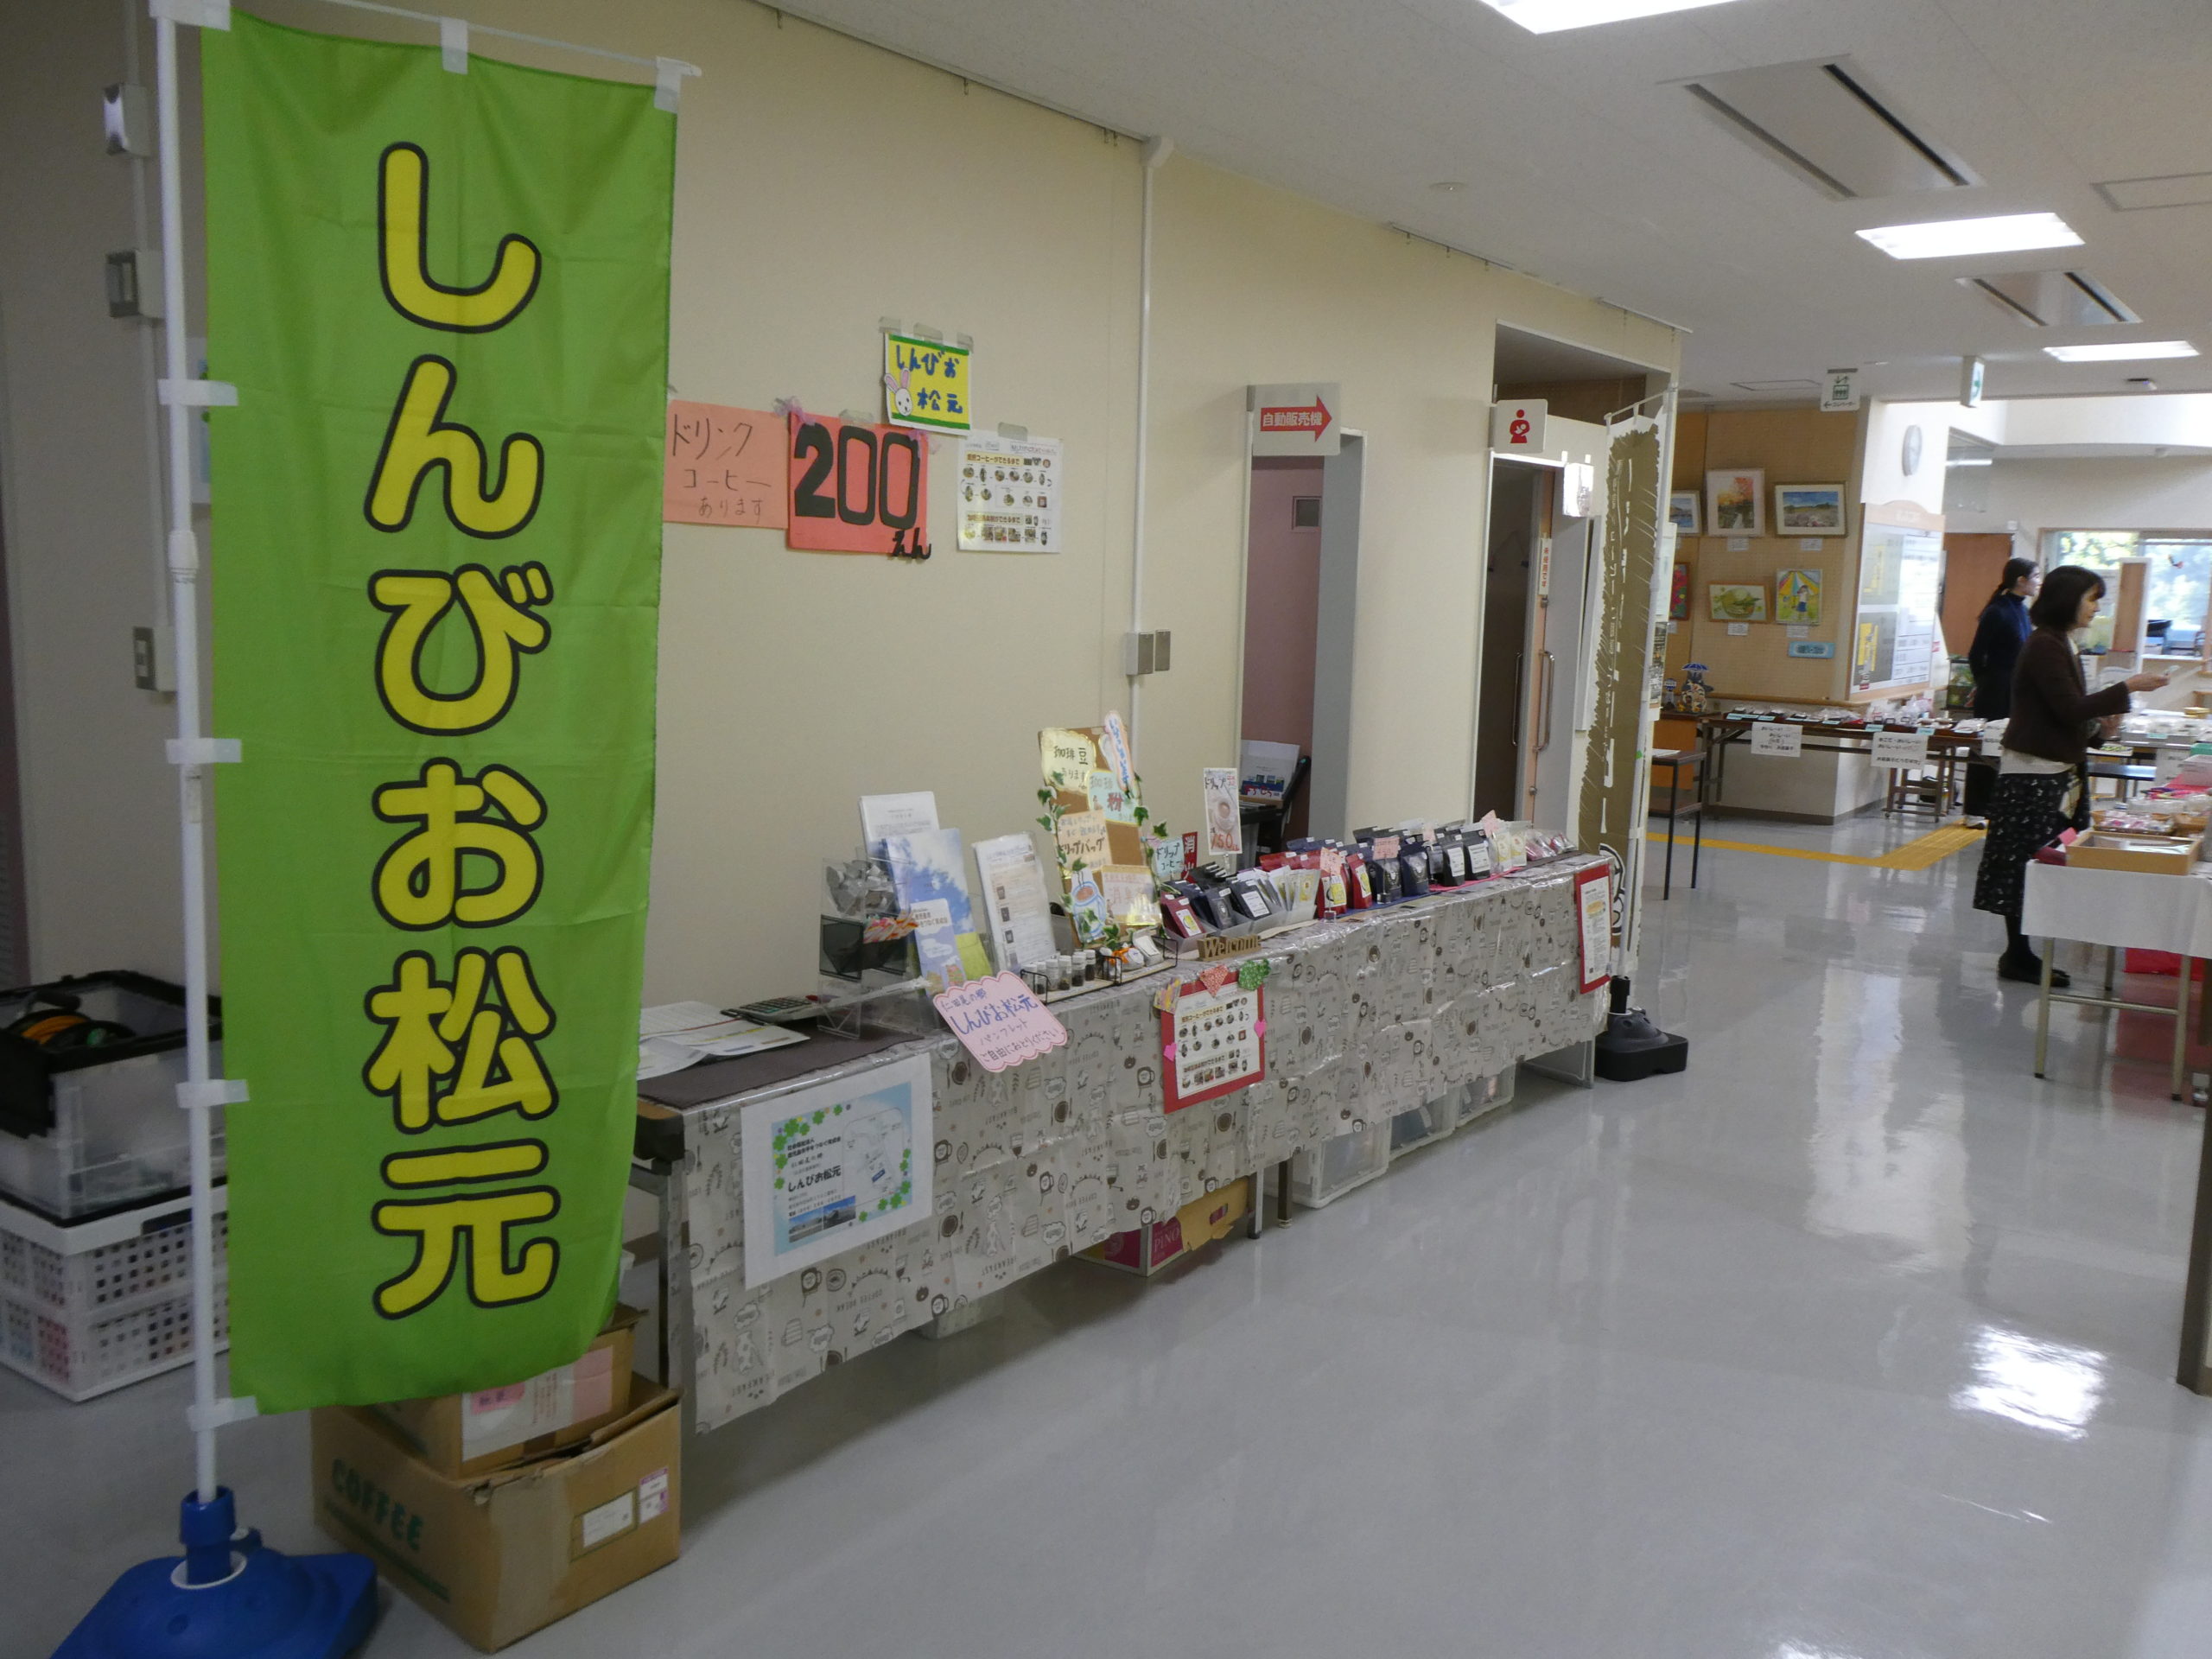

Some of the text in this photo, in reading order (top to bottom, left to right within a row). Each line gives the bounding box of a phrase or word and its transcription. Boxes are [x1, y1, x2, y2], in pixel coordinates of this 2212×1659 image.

[896, 344, 960, 378] しんびお
[917, 387, 963, 414] 松元
[1262, 410, 1322, 427] 自動販売機
[672, 413, 753, 461] ドリンク
[683, 468, 772, 492] コーヒー
[793, 422, 921, 530] 200
[698, 496, 764, 525] あります
[892, 526, 932, 560] えん
[362, 142, 559, 1320] しんびお松元
[1204, 934, 1262, 959] Welcome
[950, 994, 1039, 1035] しんびお松元
[788, 1165, 842, 1192] しんびお松元
